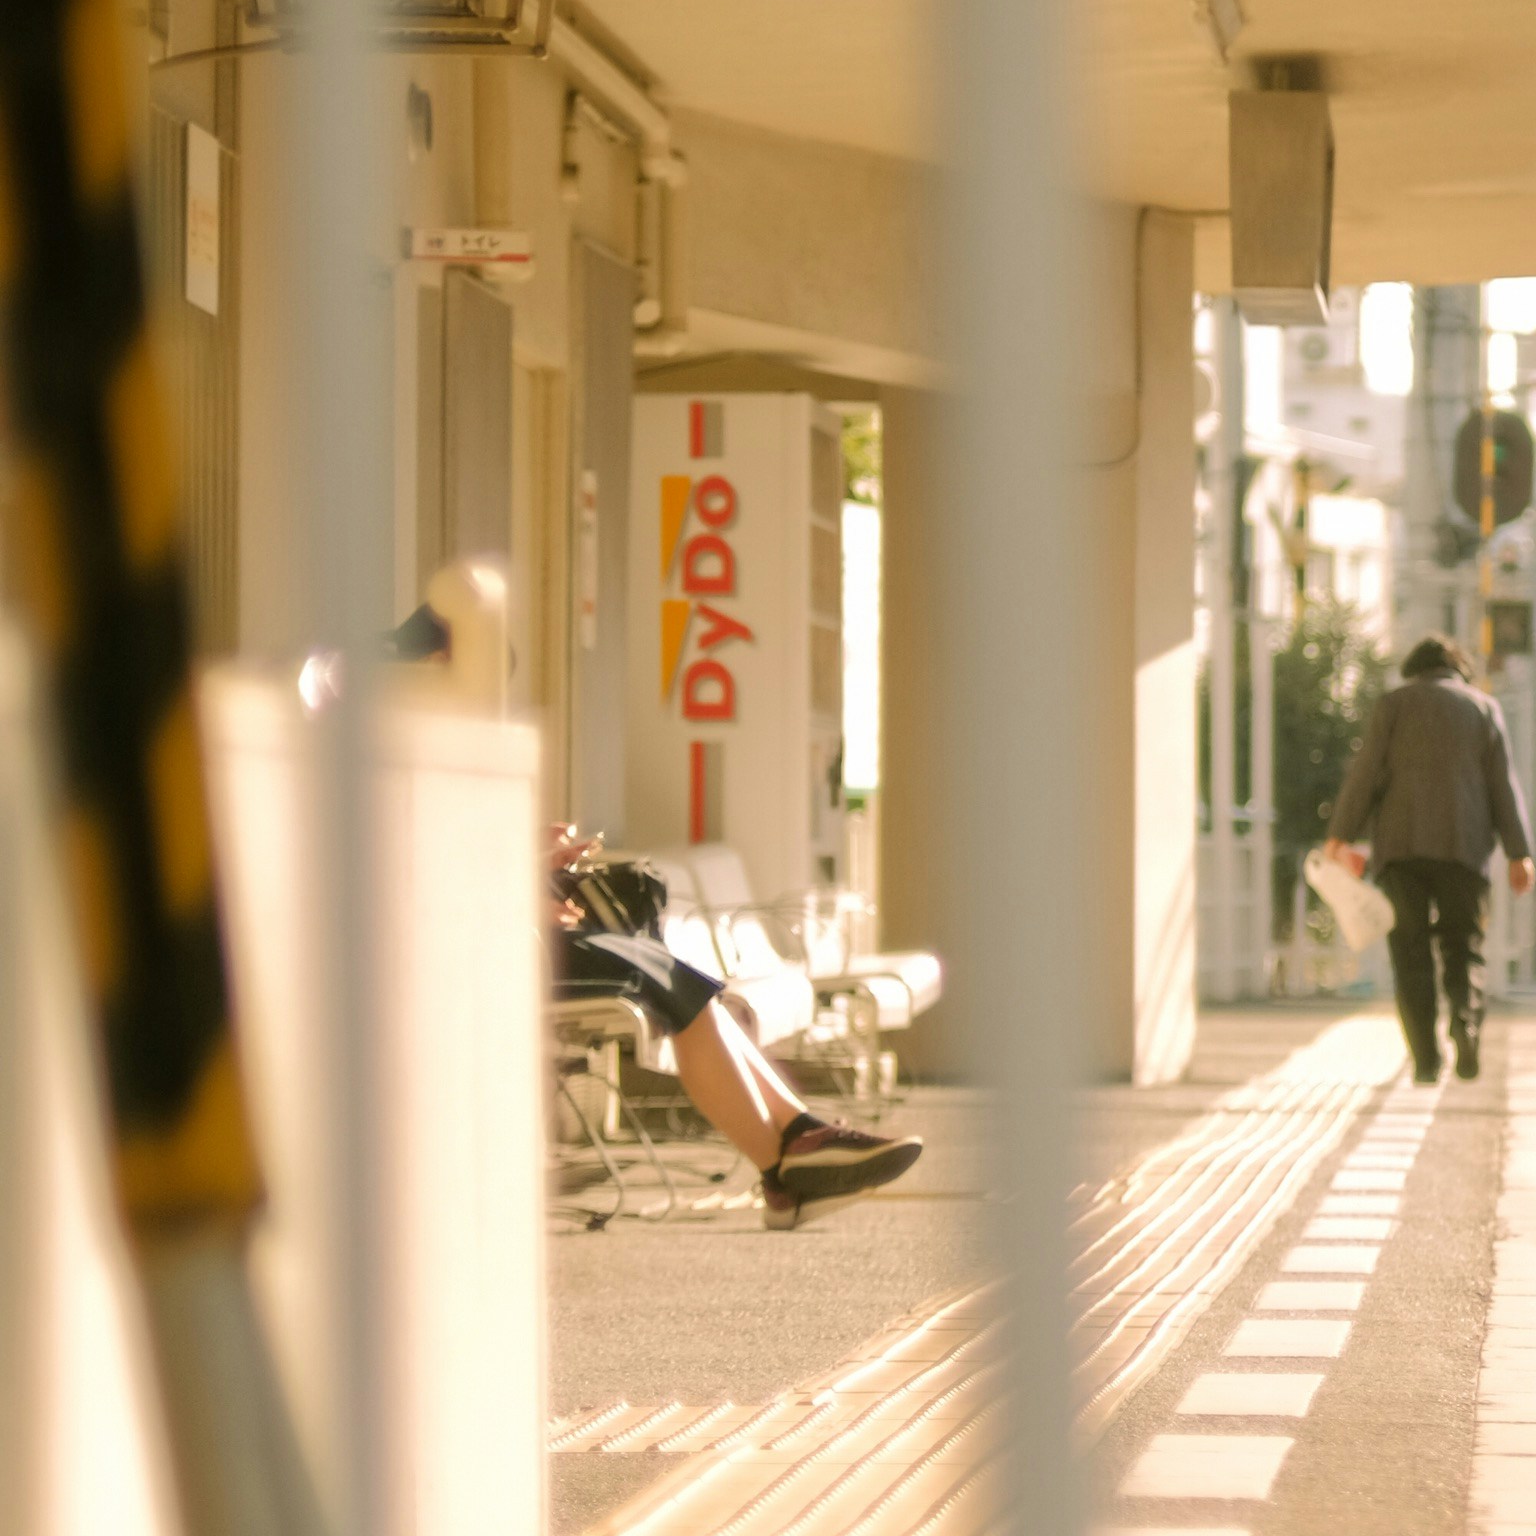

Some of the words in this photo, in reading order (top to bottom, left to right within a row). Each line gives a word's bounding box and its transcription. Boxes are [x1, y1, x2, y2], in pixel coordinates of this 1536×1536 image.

[461, 235, 500, 249] トイレ
[682, 474, 753, 720] DyDo
